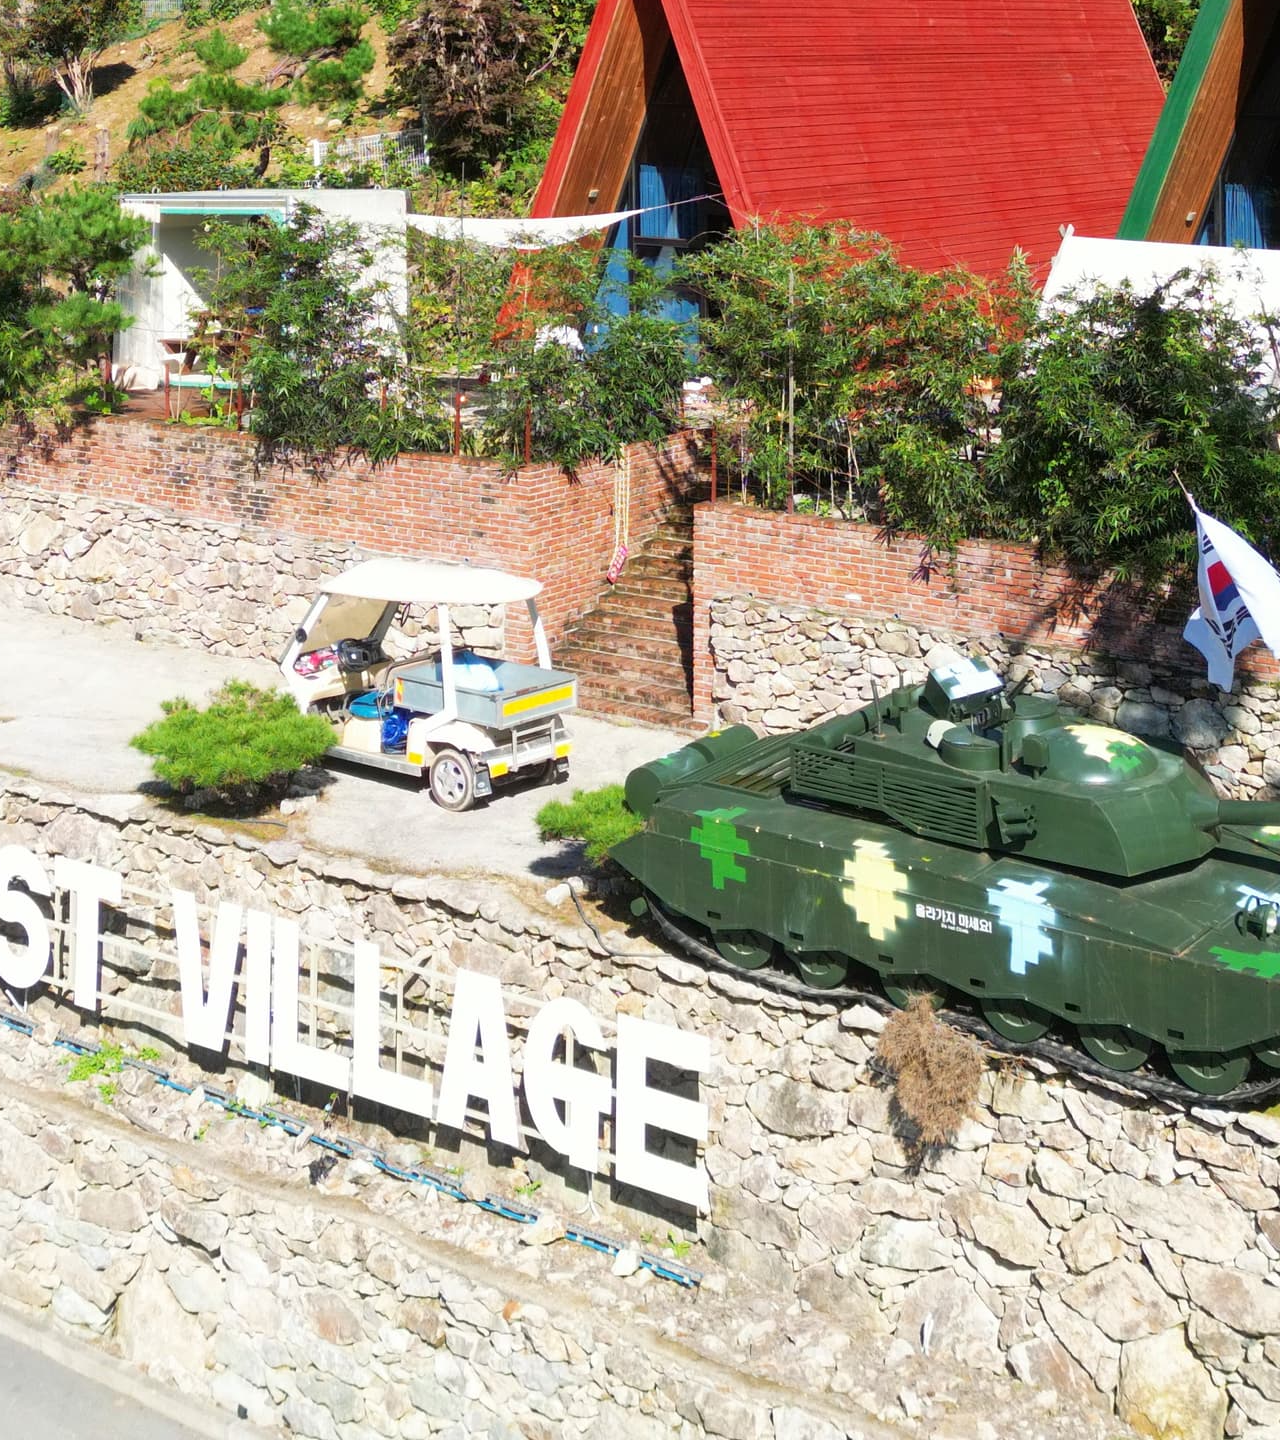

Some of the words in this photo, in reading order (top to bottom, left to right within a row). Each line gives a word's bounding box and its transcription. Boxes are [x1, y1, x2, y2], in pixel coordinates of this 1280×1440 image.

[915, 903, 956, 926] 올라가지
[958, 913, 993, 934] 마세요!
[172, 887, 711, 1214] VILLAGE
